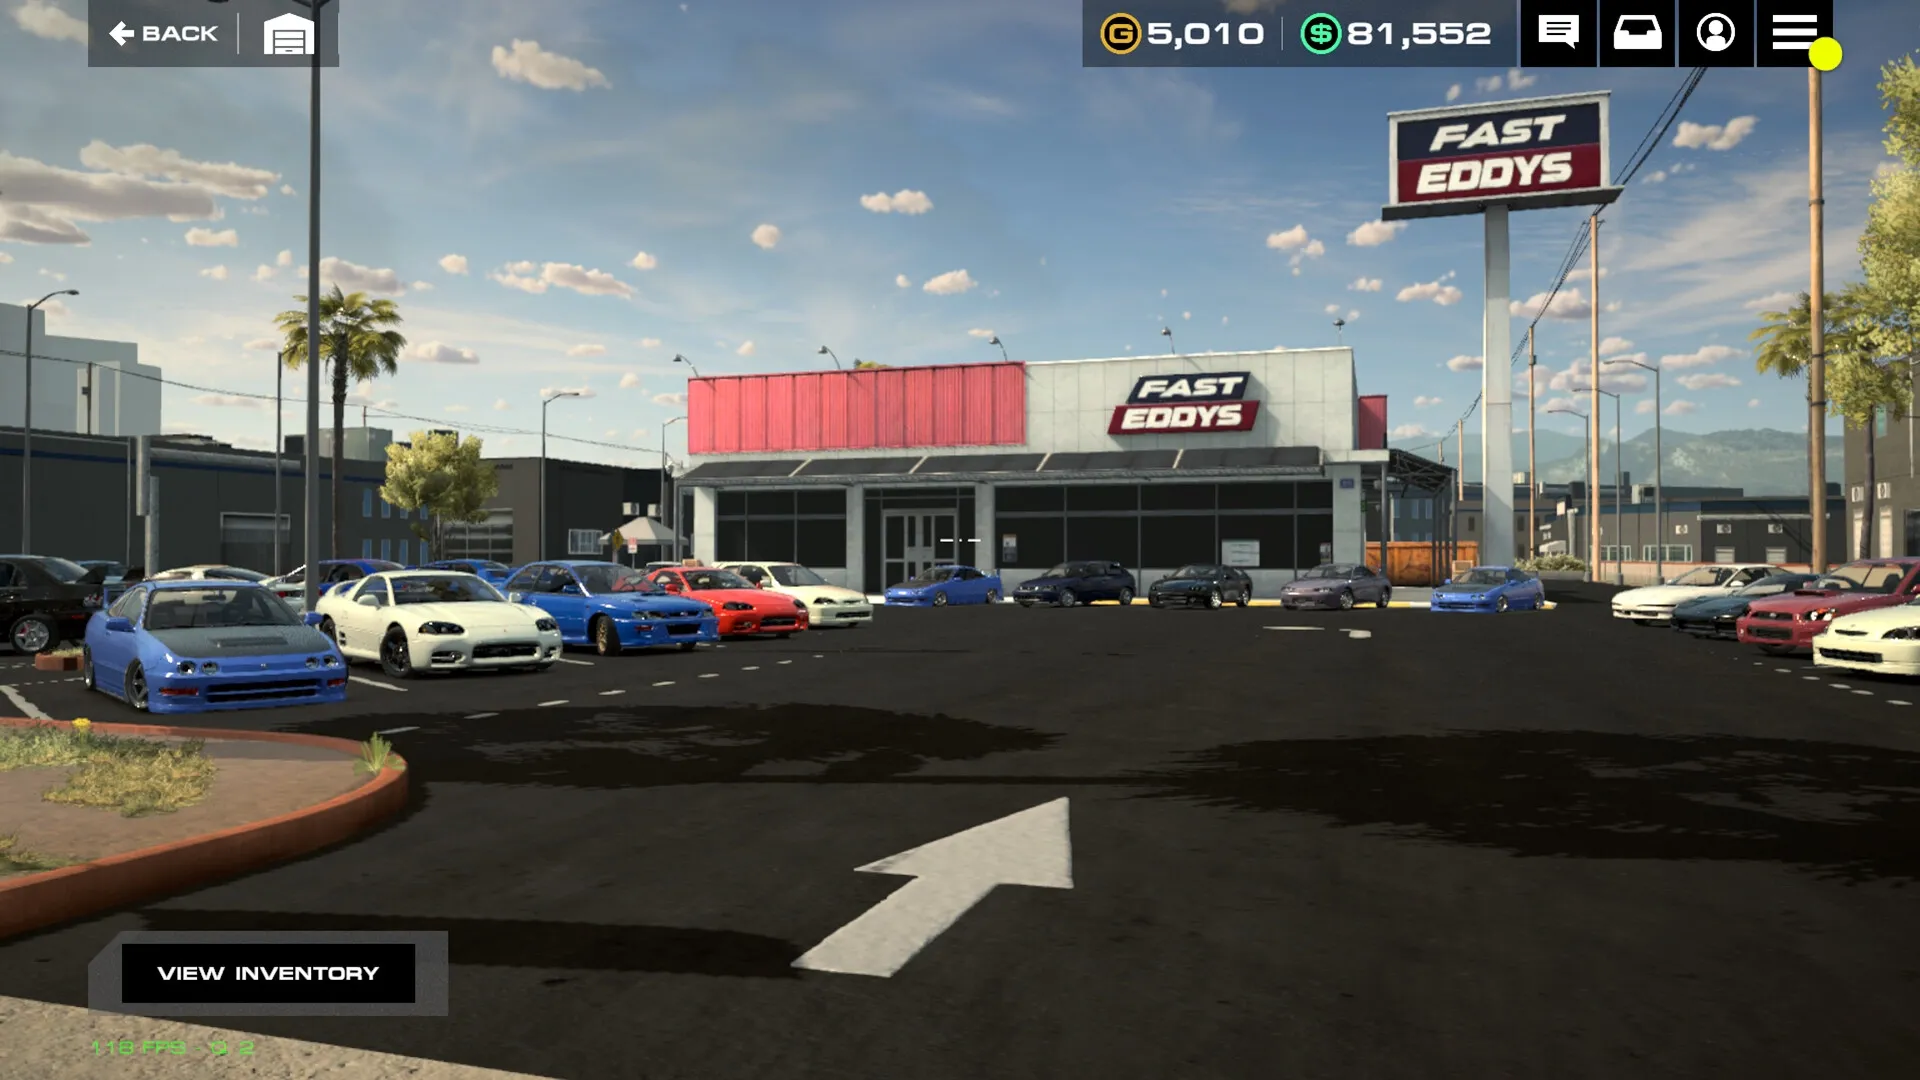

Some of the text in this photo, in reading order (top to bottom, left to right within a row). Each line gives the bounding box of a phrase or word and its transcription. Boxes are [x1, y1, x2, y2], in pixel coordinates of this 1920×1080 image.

[1429, 114, 1567, 152] FAST
[1416, 152, 1573, 194] EDDYS
[1137, 376, 1244, 399] FAST
[1121, 404, 1243, 430] EDDYS
